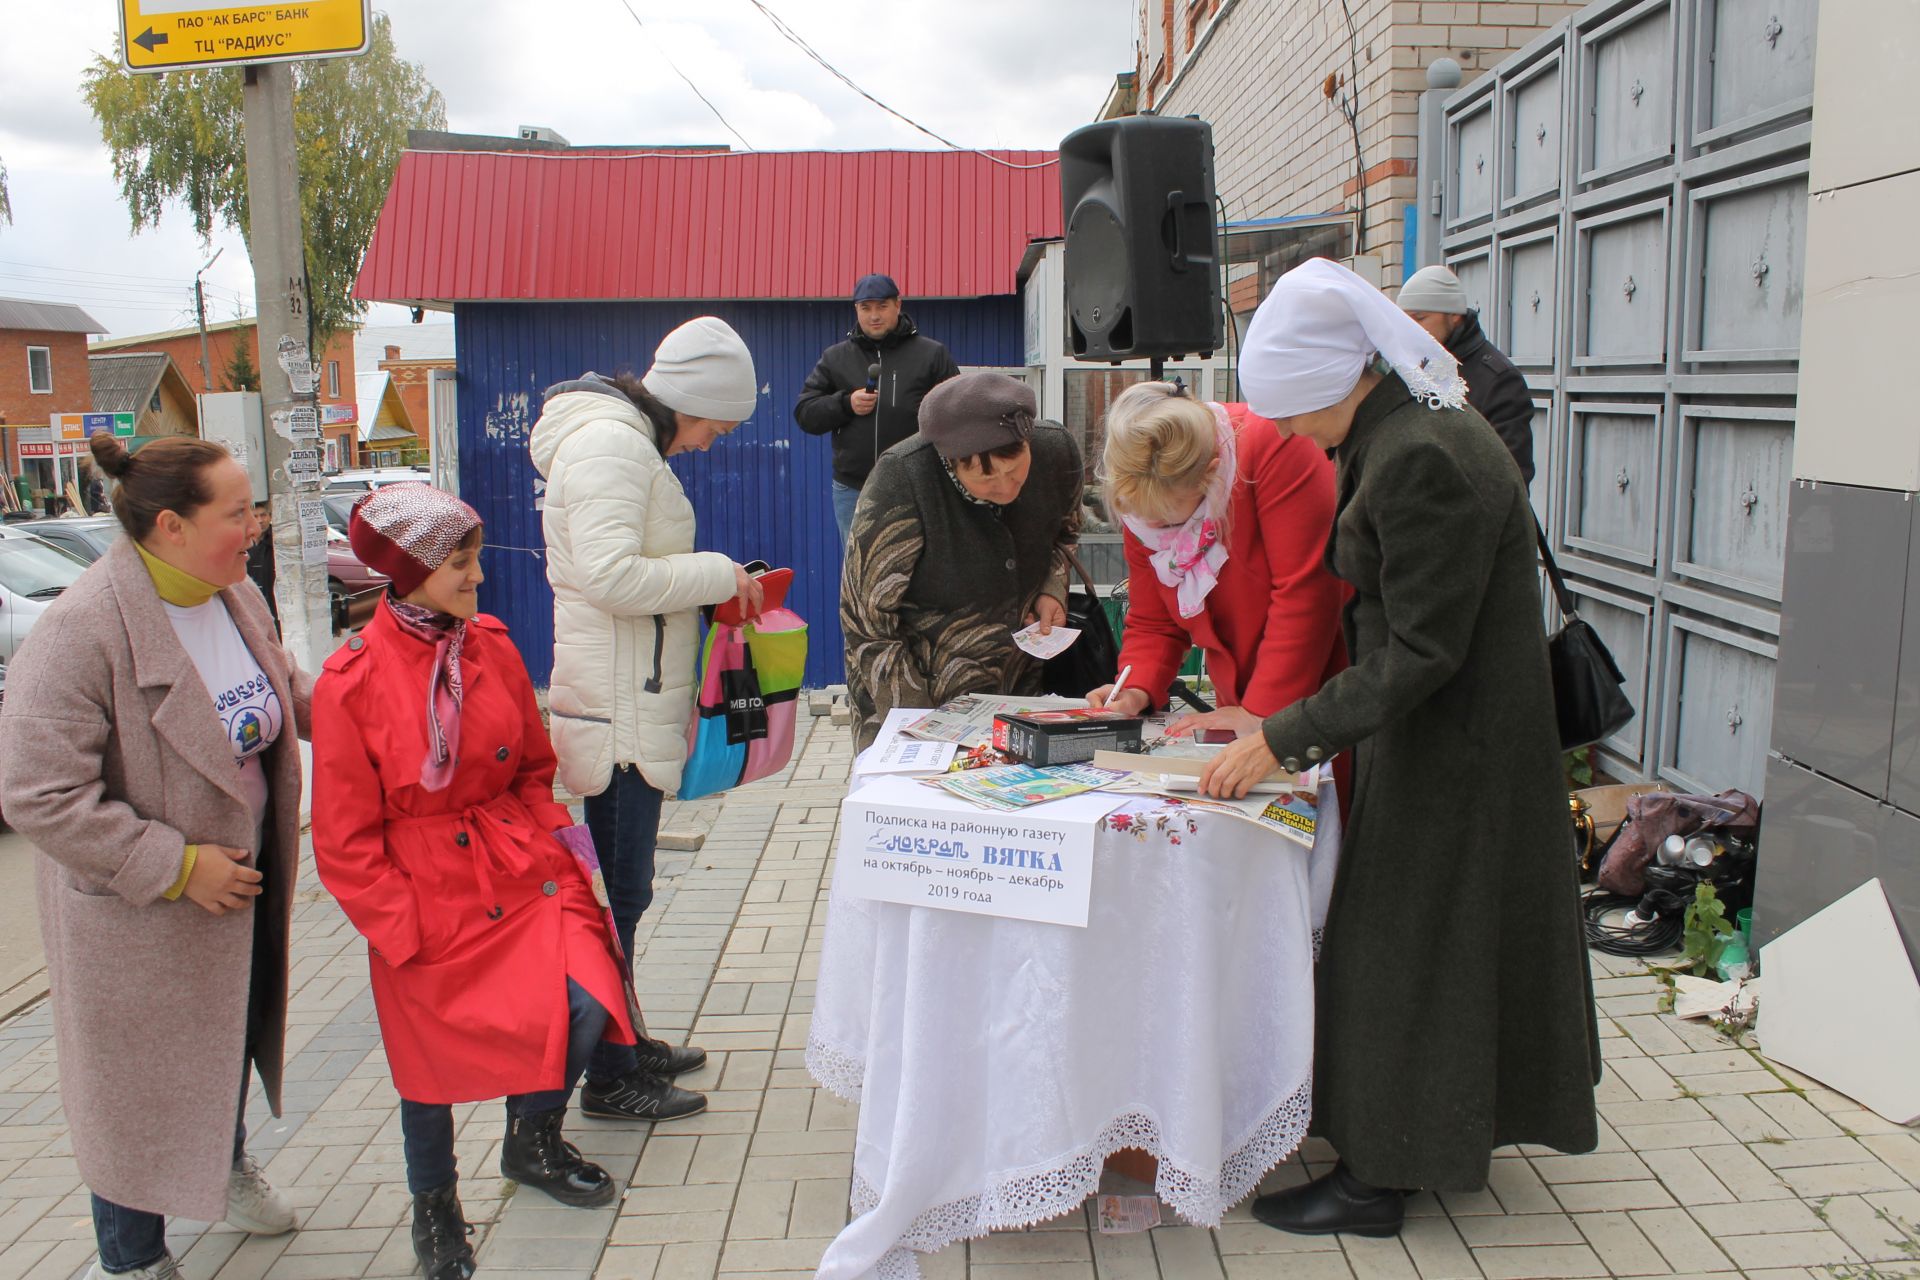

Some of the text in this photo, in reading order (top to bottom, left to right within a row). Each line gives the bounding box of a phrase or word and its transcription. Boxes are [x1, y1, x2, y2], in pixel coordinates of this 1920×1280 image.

[177, 17, 204, 29] ПАО
[275, 8, 309, 21] БАНК
[194, 39, 215, 54] ТЦ
[290, 296, 302, 314] 32
[292, 451, 317, 460] ДЕНЬГИ
[865, 811, 1066, 845] Подписка на районную газету
[982, 845, 1063, 872] ВЯТКА
[863, 857, 878, 869] на
[881, 860, 932, 875] октябрь
[946, 868, 994, 883] ноябрь
[1008, 874, 1064, 890] декабрь
[927, 883, 992, 904] 2019 года
